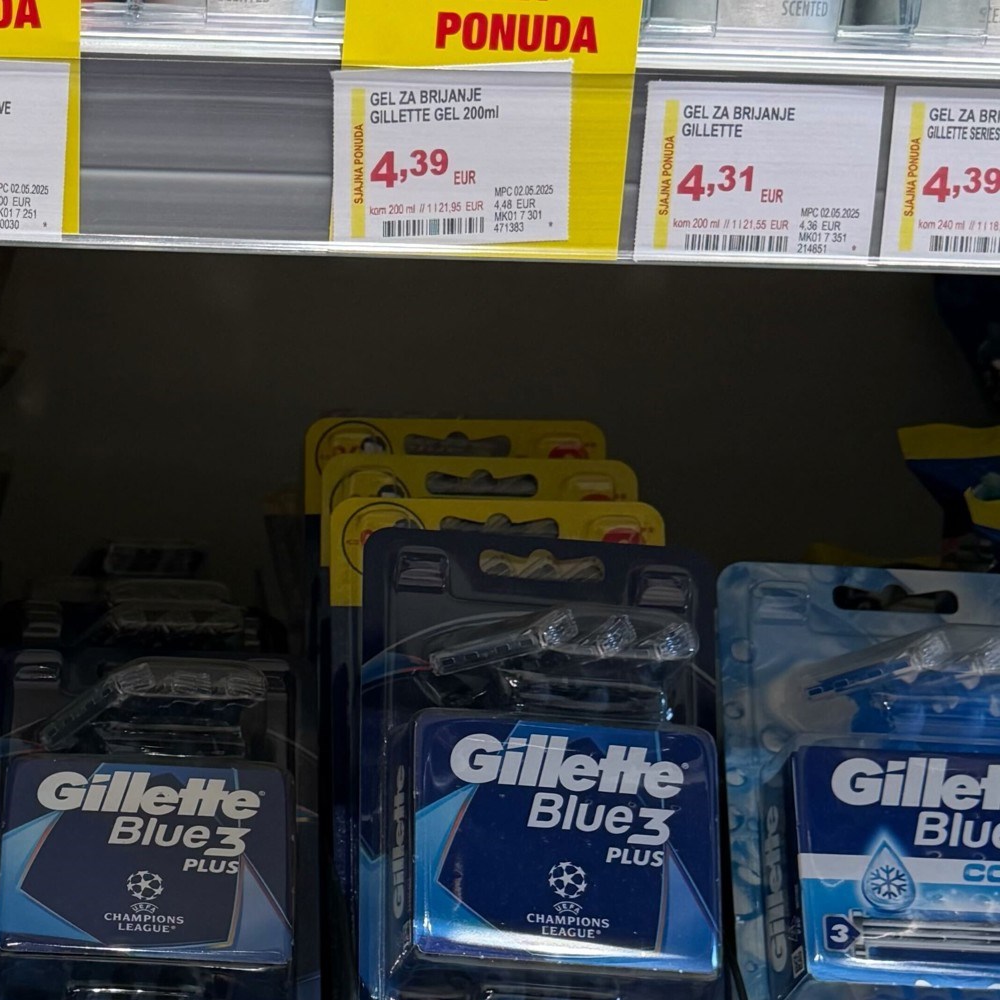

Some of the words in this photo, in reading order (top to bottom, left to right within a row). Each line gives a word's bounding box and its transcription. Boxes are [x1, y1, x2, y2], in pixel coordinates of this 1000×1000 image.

[781, 0, 827, 17] SCENTED
[435, 11, 598, 53] PONUDA
[370, 92, 395, 106] GEL
[399, 91, 416, 105] ZA
[420, 88, 482, 104] BRIJANJE
[370, 108, 430, 124] GILLETTE
[434, 107, 459, 121] GEL
[464, 105, 499, 120] 200ml
[684, 106, 709, 119] GEL
[712, 106, 729, 119] ZA
[733, 107, 795, 121] BRIJANJE
[929, 108, 954, 122] GEL
[958, 109, 975, 122] ZA
[682, 124, 743, 138] GILLETTE
[927, 126, 967, 139] GILLETTE
[969, 127, 1000, 141] SERIES
[354, 123, 363, 165] PONUDA
[662, 136, 675, 177] PONUDA
[908, 137, 921, 177] PONUDA
[370, 149, 449, 188] 4,39
[454, 170, 476, 185] EUR
[11, 184, 49, 195] 02.05.2025
[354, 167, 363, 204] SJAJNA
[495, 187, 512, 196] MPC
[514, 185, 553, 196] 02.05.2025
[677, 165, 754, 201] 4,31
[760, 189, 783, 203] EUR
[13, 197, 31, 207] EUR
[517, 198, 535, 209] EUR
[659, 179, 671, 215] SJAJNA
[904, 180, 915, 217] SJAJNA
[801, 208, 818, 217] MPC
[821, 208, 859, 218] 02.05.2025
[494, 222, 524, 232] 471383
[822, 221, 841, 231] EUR
[450, 733, 684, 798] Gillette
[37, 771, 261, 820] Gillette
[391, 765, 405, 919] Gillette
[606, 847, 665, 867] PLUS
[182, 858, 239, 874] PLUS
[765, 805, 787, 972] Gillette
[131, 903, 157, 913] UEFA
[554, 903, 581, 913] UEFA
[104, 913, 184, 924] CHAMPIONS
[526, 913, 610, 928] CHAMPIONS
[118, 923, 170, 933] LEAGUE
[542, 926, 596, 939] LEAGUE
[830, 924, 849, 942] 3
